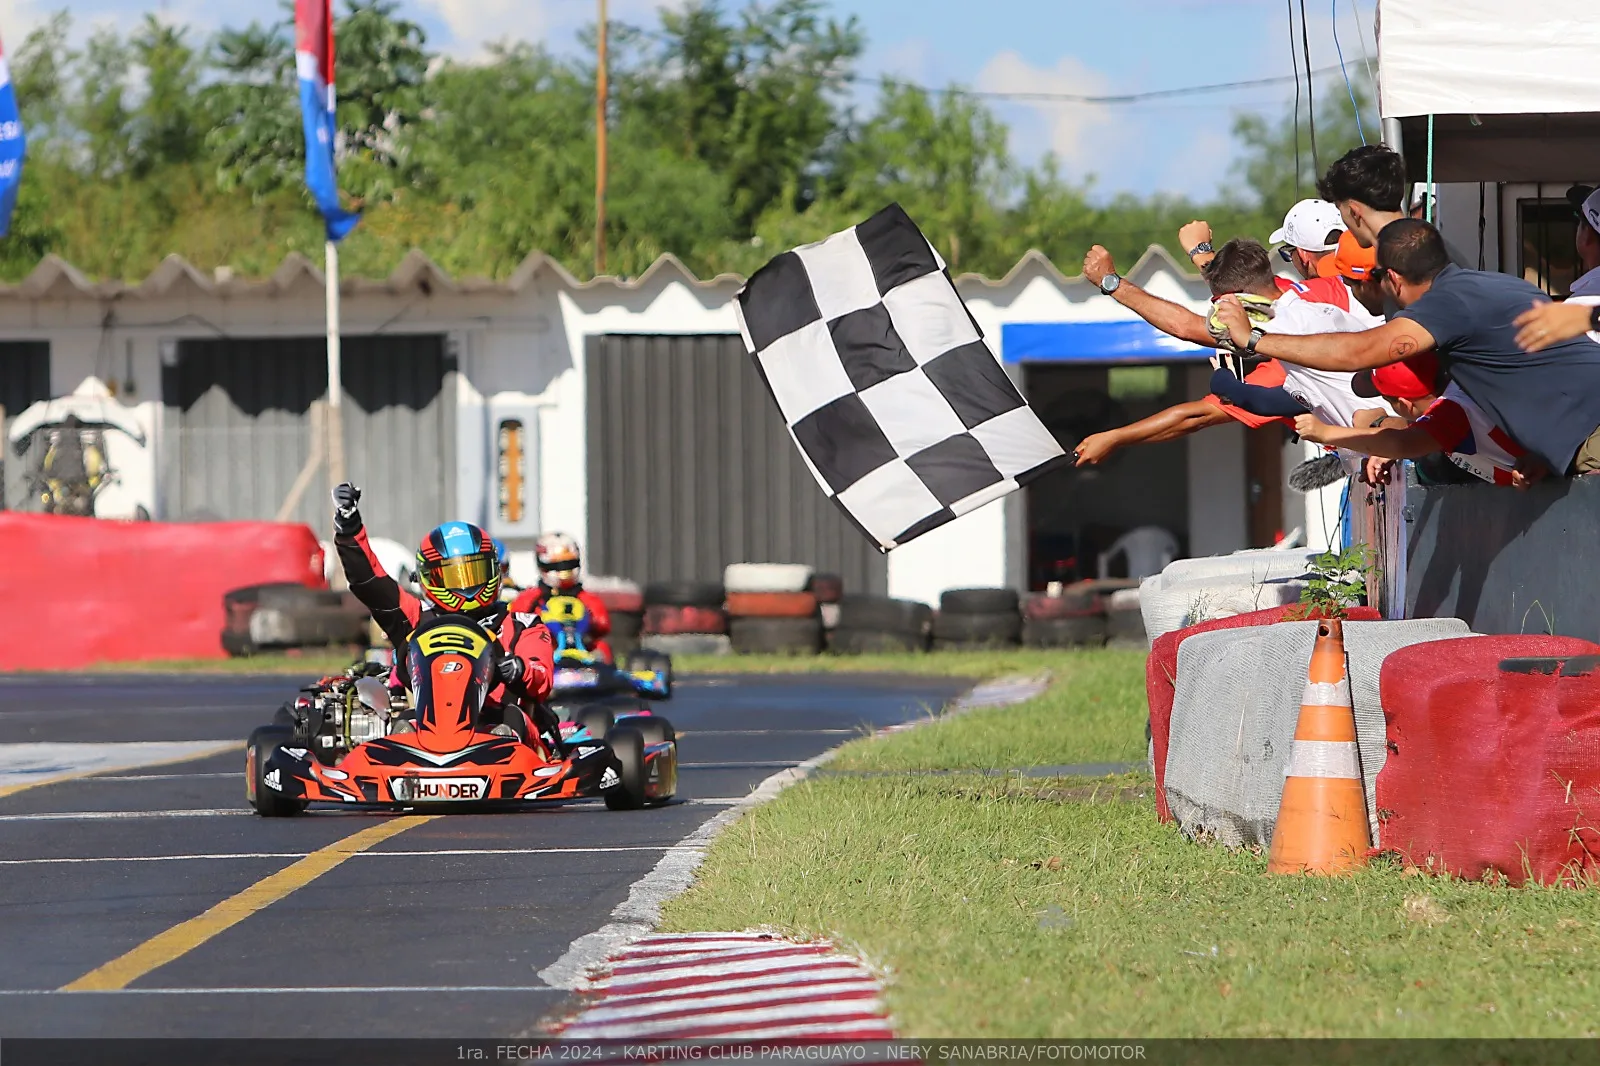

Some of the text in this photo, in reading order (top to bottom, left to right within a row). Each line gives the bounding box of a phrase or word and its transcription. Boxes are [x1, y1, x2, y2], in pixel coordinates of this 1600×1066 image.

[429, 632, 475, 651] 3
[409, 783, 479, 799] HUNDER
[599, 777, 620, 790] adidas
